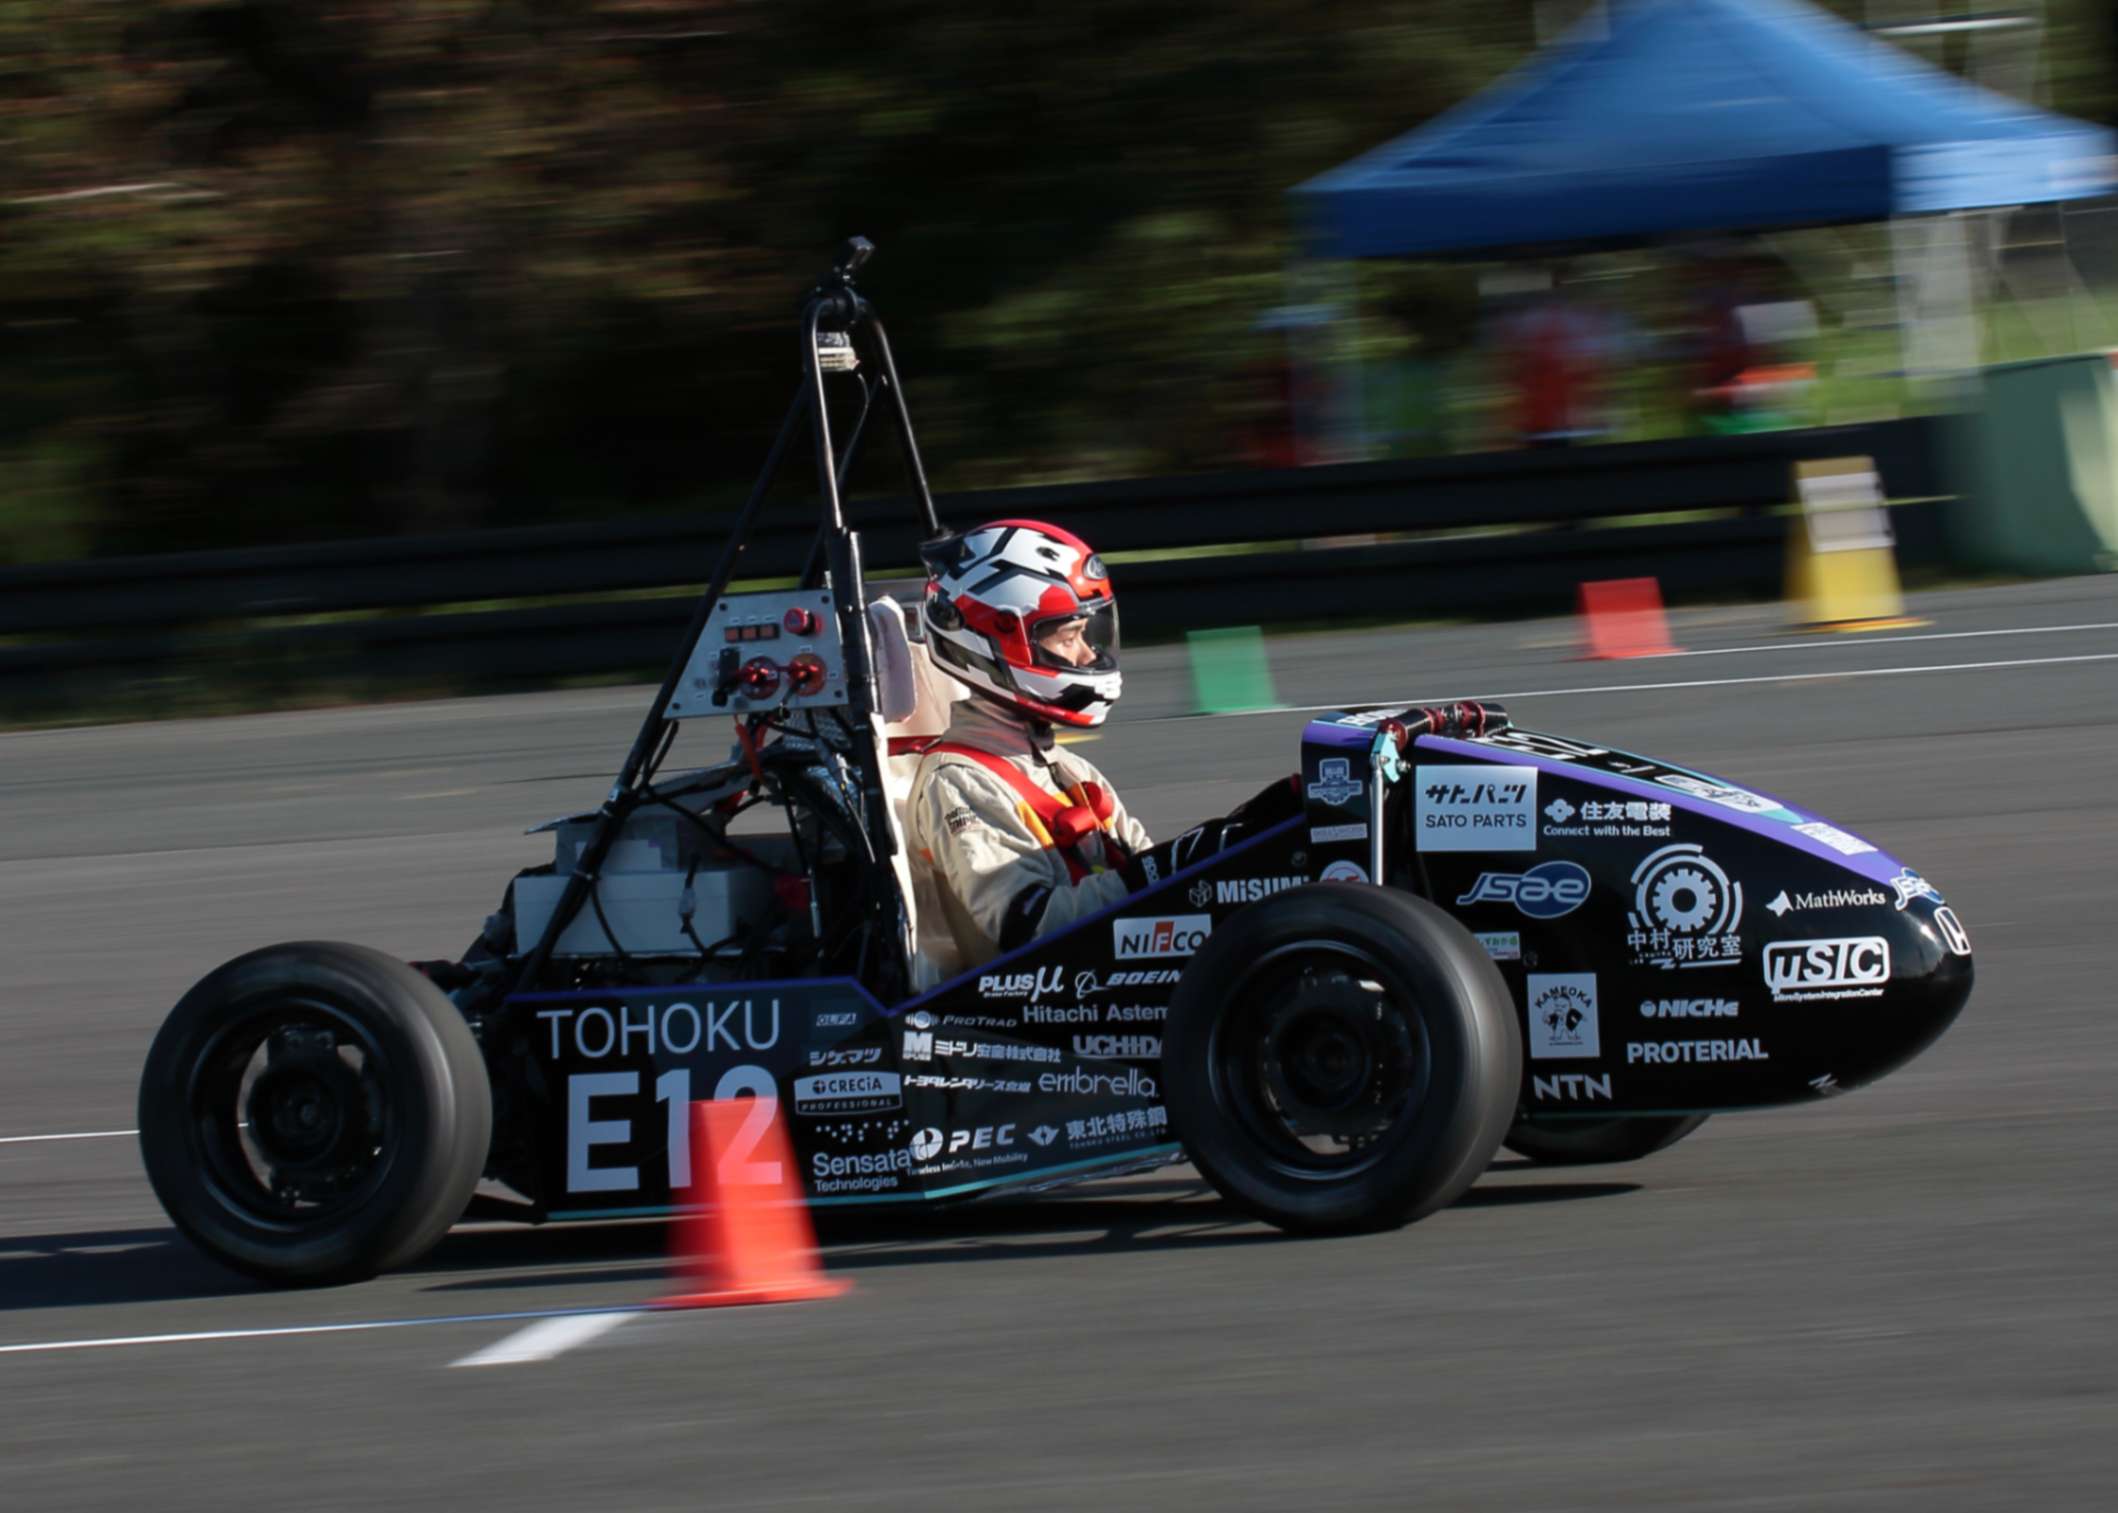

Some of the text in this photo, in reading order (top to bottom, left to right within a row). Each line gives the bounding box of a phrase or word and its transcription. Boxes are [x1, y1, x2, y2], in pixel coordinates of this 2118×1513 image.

[1425, 813, 1527, 829] SATO PARTS
[1543, 825, 1671, 837] Connect with the Best
[1796, 888, 1886, 910] MathWorks
[1120, 930, 1206, 955] NIFCO
[1627, 928, 1743, 960] 中村研究室
[1534, 985, 1593, 1008] KAMEOKA
[1023, 1003, 1099, 1024] Hitachi
[536, 998, 780, 1060] TOHOKU
[1626, 1038, 1769, 1064] PROTERIAL
[1532, 1072, 1613, 1100] NTN
[801, 1098, 893, 1111] PROFESSIONAL
[566, 1064, 784, 1193] E12
[948, 1122, 1016, 1154] PEC
[812, 1145, 913, 1177] Sensata
[814, 1174, 899, 1193] Technologies
